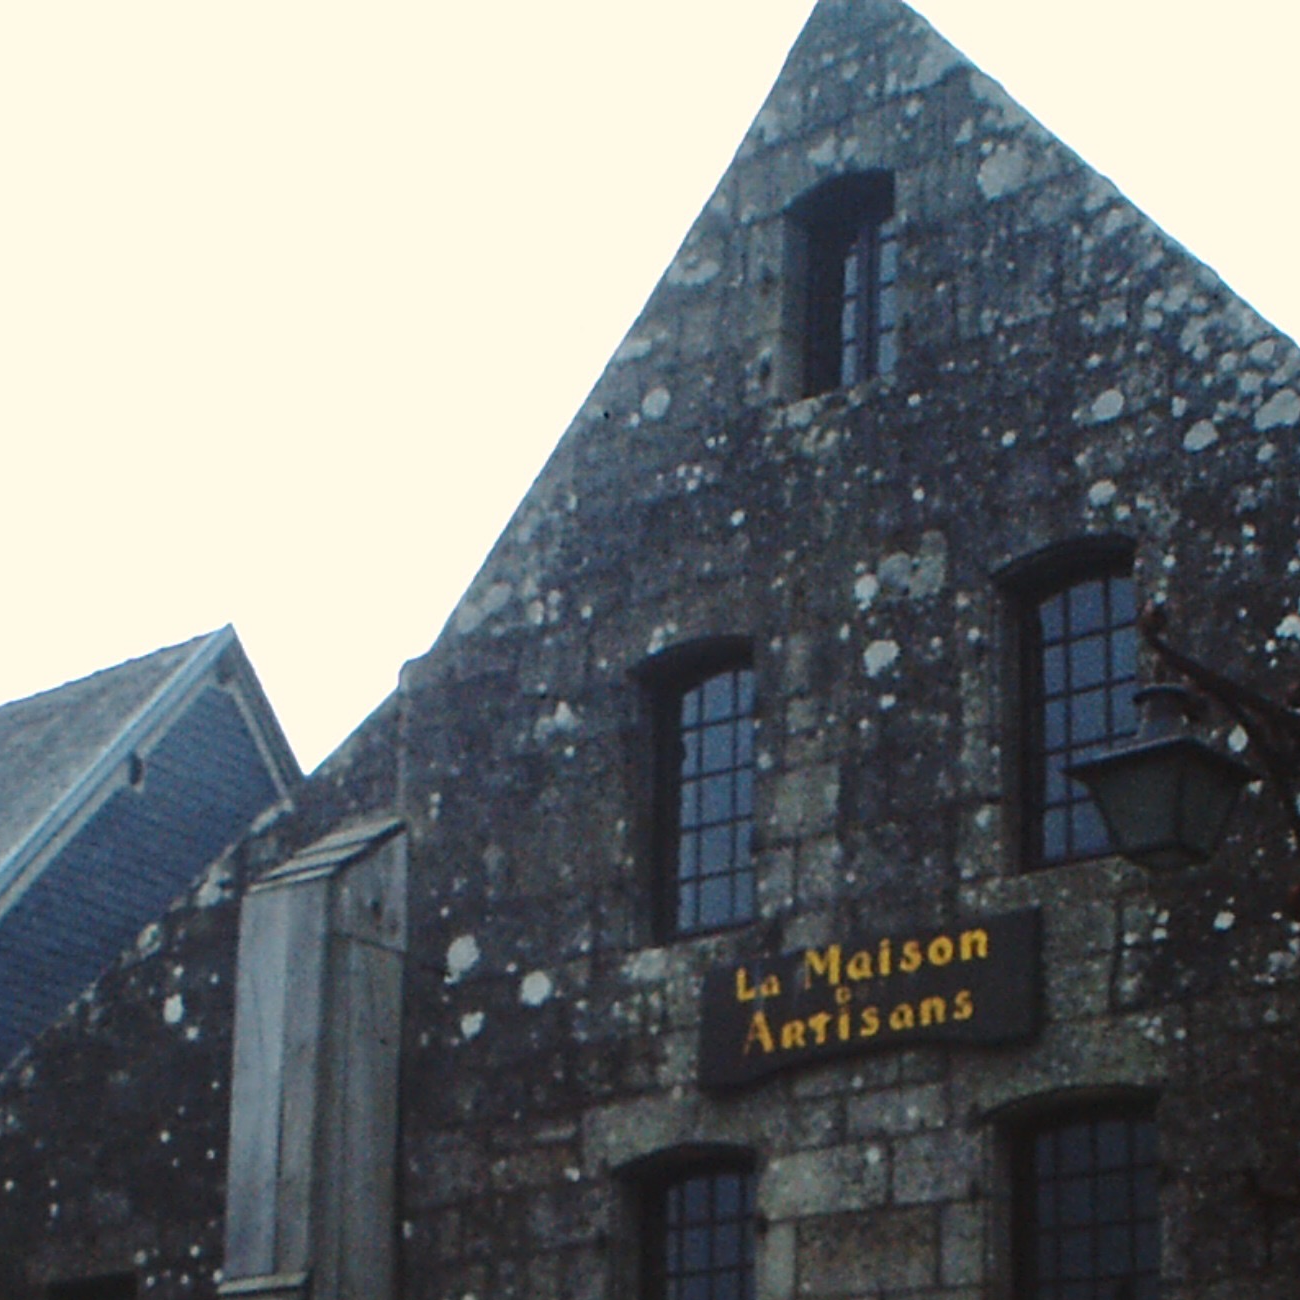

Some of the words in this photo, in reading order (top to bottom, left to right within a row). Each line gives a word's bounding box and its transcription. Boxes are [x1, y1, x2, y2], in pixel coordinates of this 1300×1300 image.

[735, 966, 781, 1001] La
[805, 927, 989, 990] Maison
[743, 988, 974, 1055] Artisans
